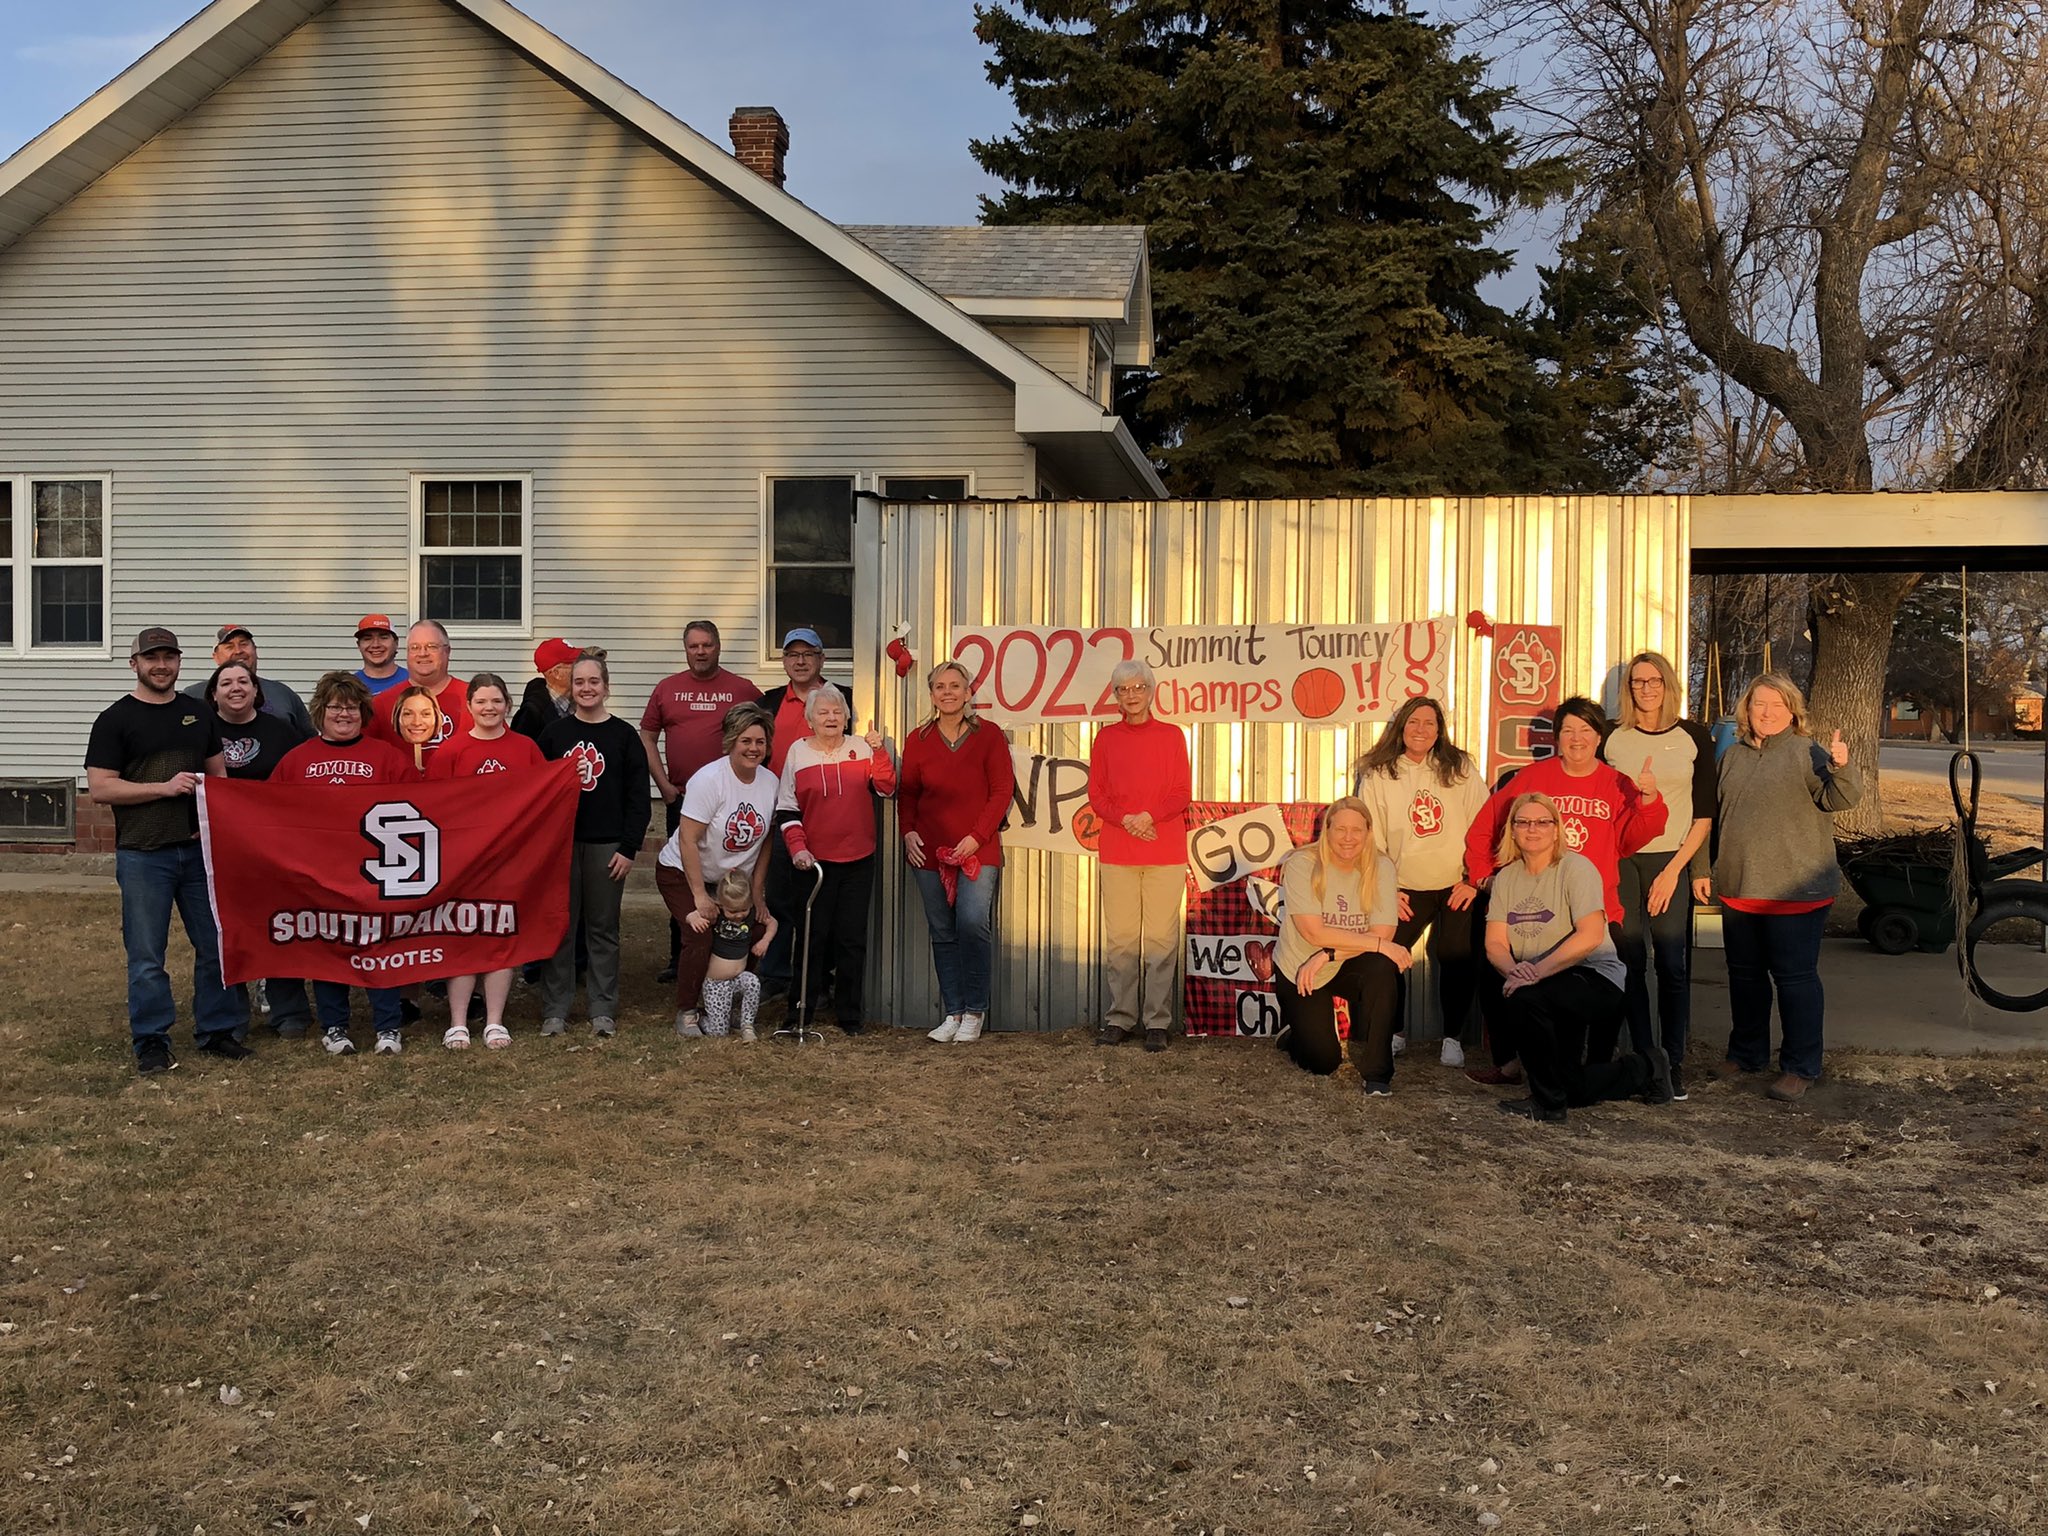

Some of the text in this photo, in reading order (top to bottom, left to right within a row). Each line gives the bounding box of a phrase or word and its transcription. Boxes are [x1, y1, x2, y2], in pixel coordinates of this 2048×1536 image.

[953, 624, 1390, 716] 2022 Summit Tourney
[674, 692, 733, 703] THE ALAMO
[1154, 678, 1283, 719] Champs
[304, 760, 373, 778] COYOTES
[1547, 795, 1611, 821] OYOTES
[363, 802, 440, 898] SD
[1190, 821, 1275, 882] GO
[270, 899, 518, 946] SOUTH DAKOTA
[350, 947, 444, 972] COYOTES
[1190, 938, 1242, 975] We
[1236, 990, 1280, 1036] Ch
